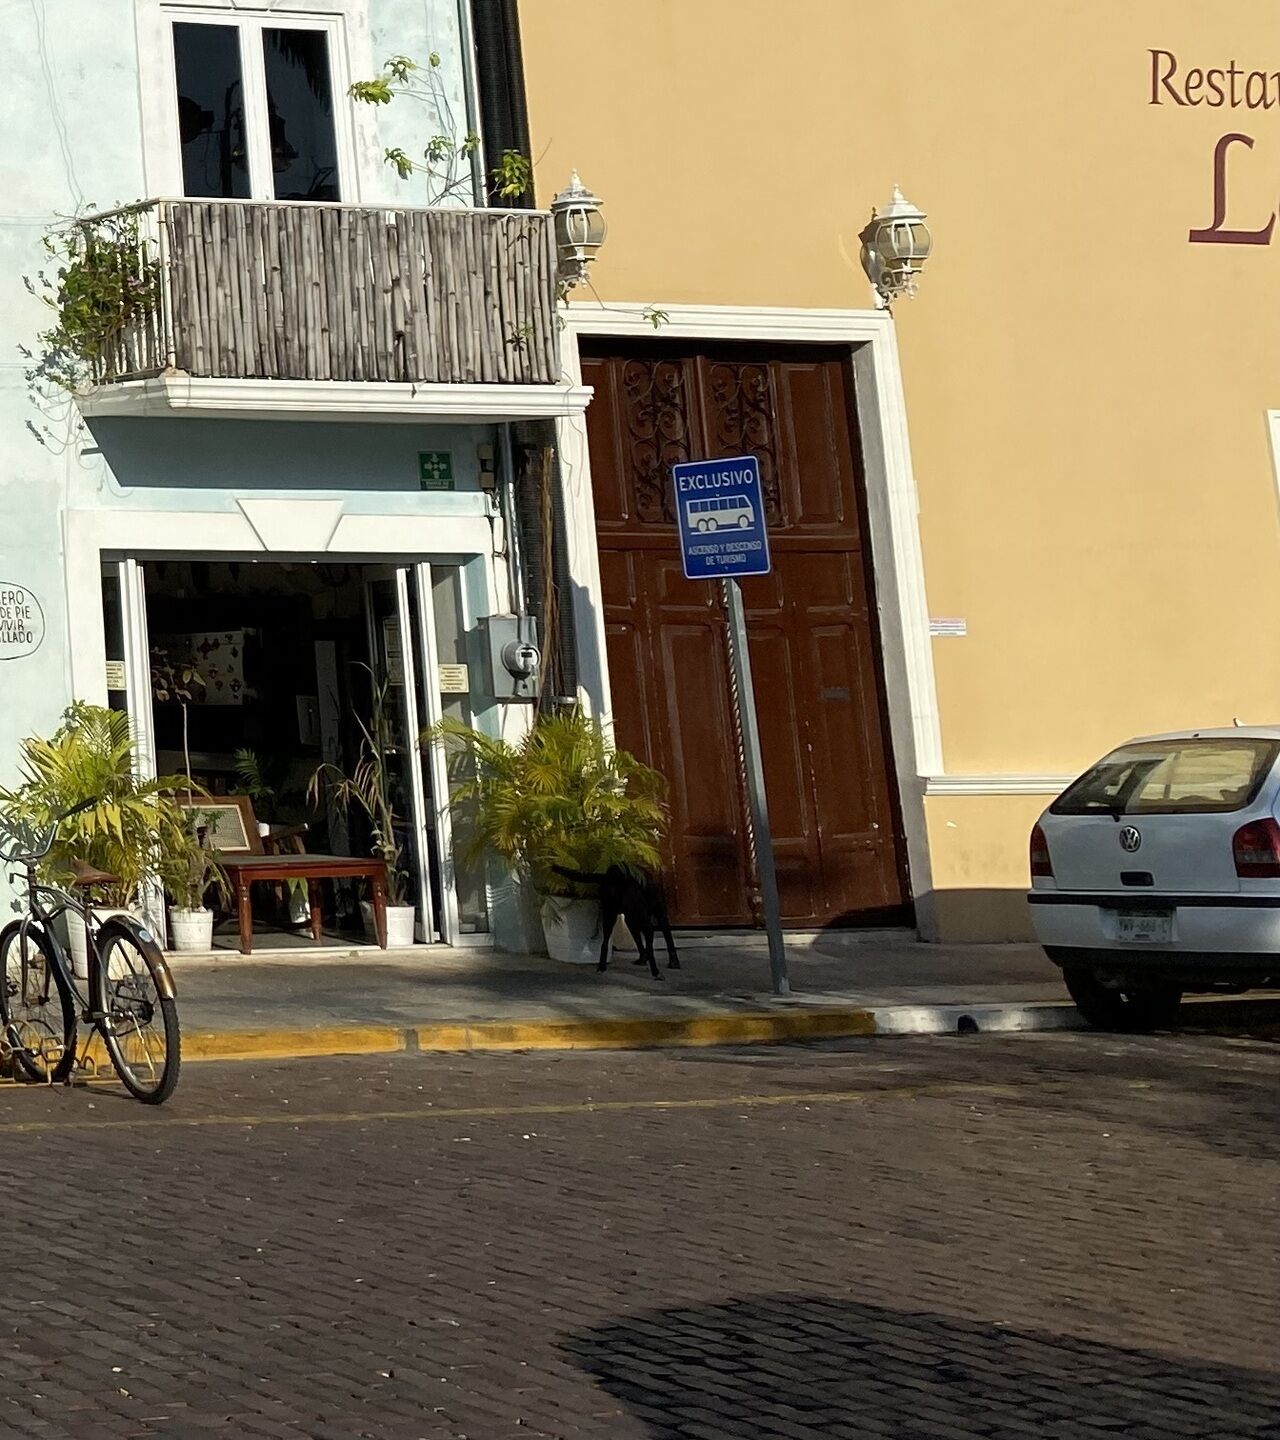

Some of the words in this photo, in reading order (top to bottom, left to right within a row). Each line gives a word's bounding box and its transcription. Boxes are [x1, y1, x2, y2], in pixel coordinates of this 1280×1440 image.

[1188, 132, 1280, 245] L
[680, 469, 754, 491] EXCLUSIVO
[688, 544, 719, 556] ASCENSO
[720, 544, 726, 553] Y
[726, 540, 761, 552] DESCENSO
[705, 556, 715, 565] DE
[716, 553, 746, 564] TURISMO
[0, 607, 11, 619] DE
[15, 606, 31, 619] PIE
